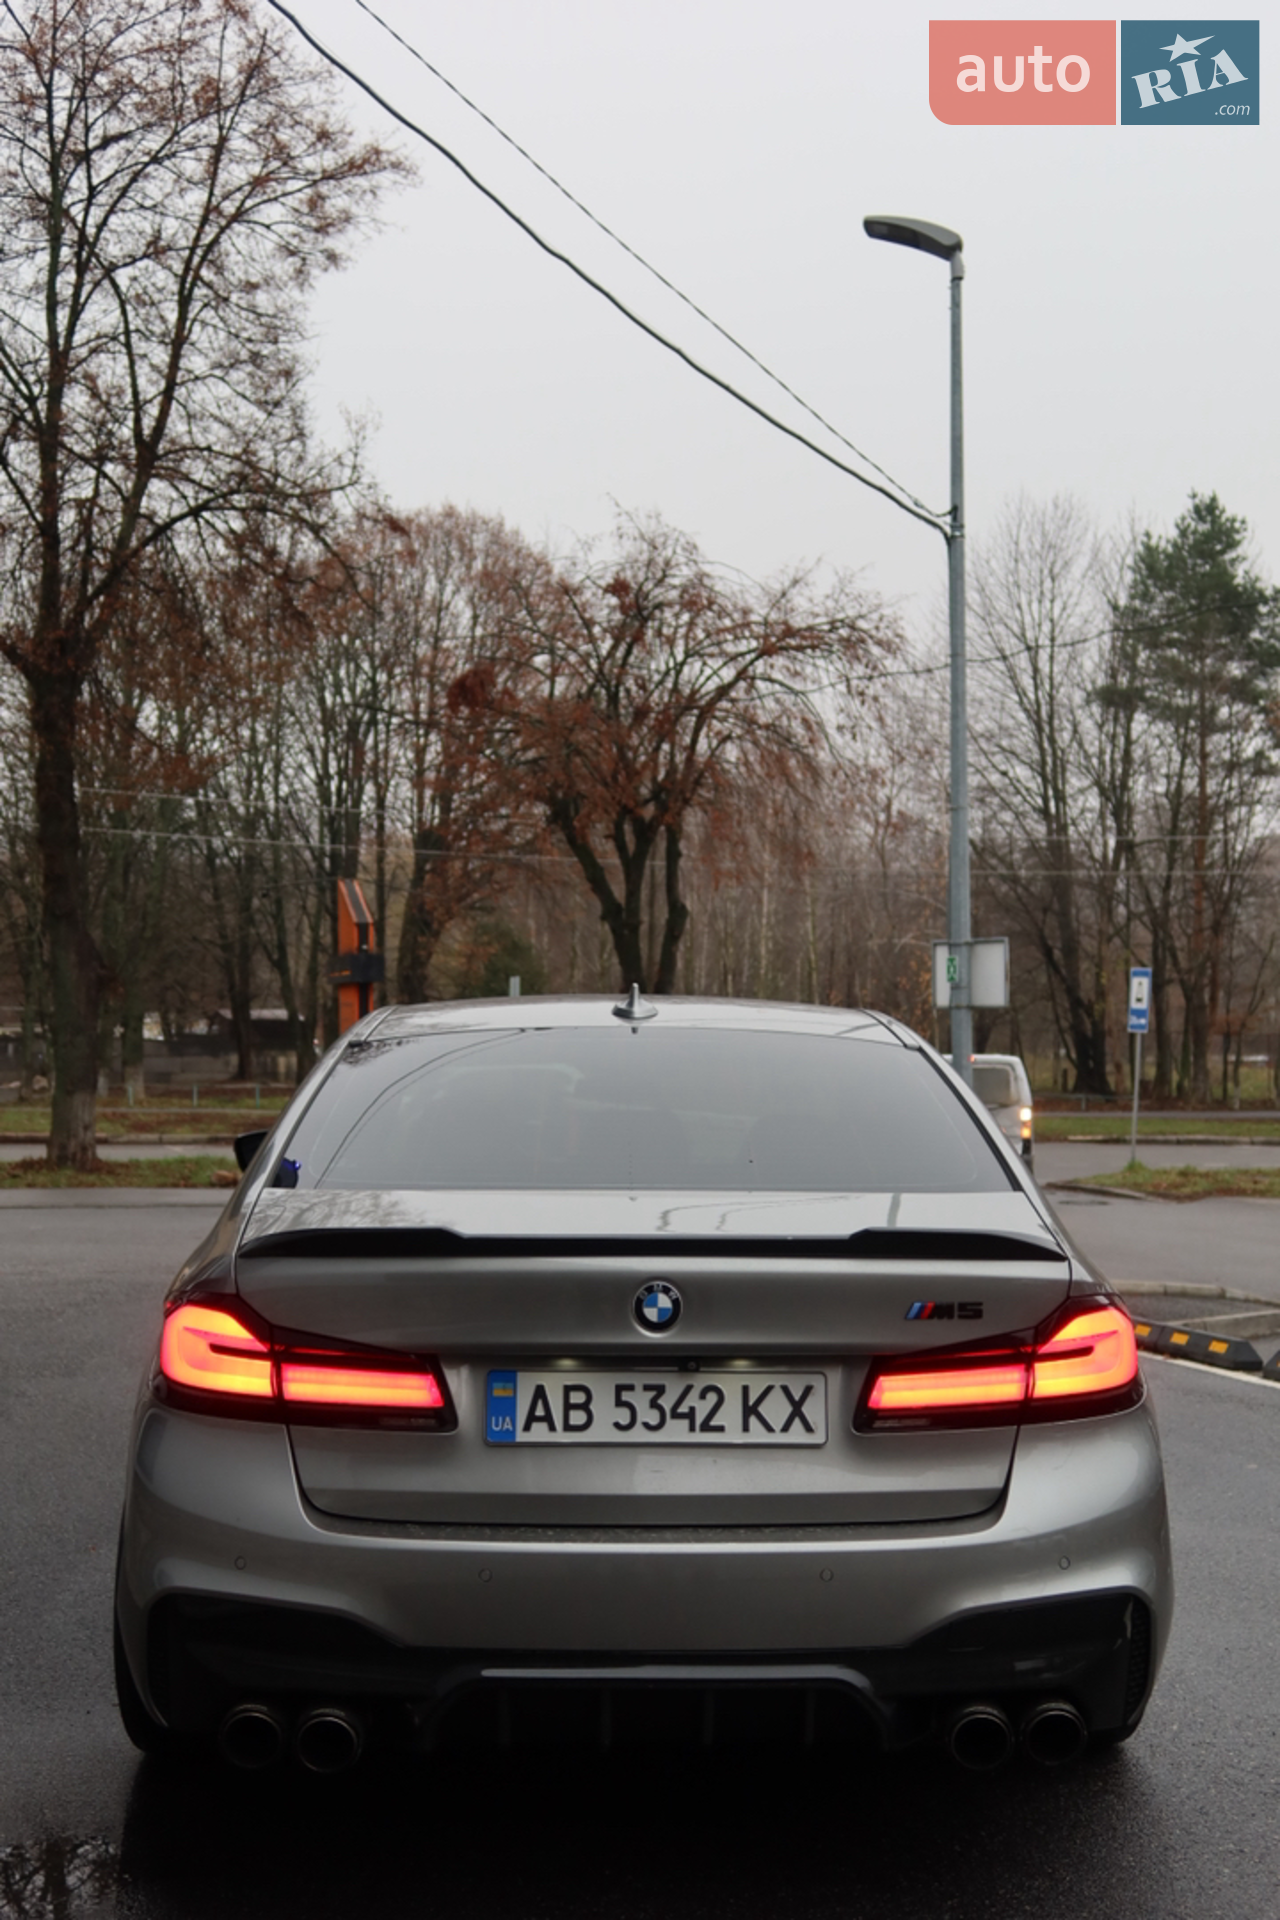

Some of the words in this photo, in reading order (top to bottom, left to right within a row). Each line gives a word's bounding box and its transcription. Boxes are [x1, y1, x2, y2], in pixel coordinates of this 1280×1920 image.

[491, 1416, 513, 1432] UA
[522, 1383, 595, 1433] AB
[612, 1383, 727, 1433] 5342
[741, 1383, 816, 1433] KX
